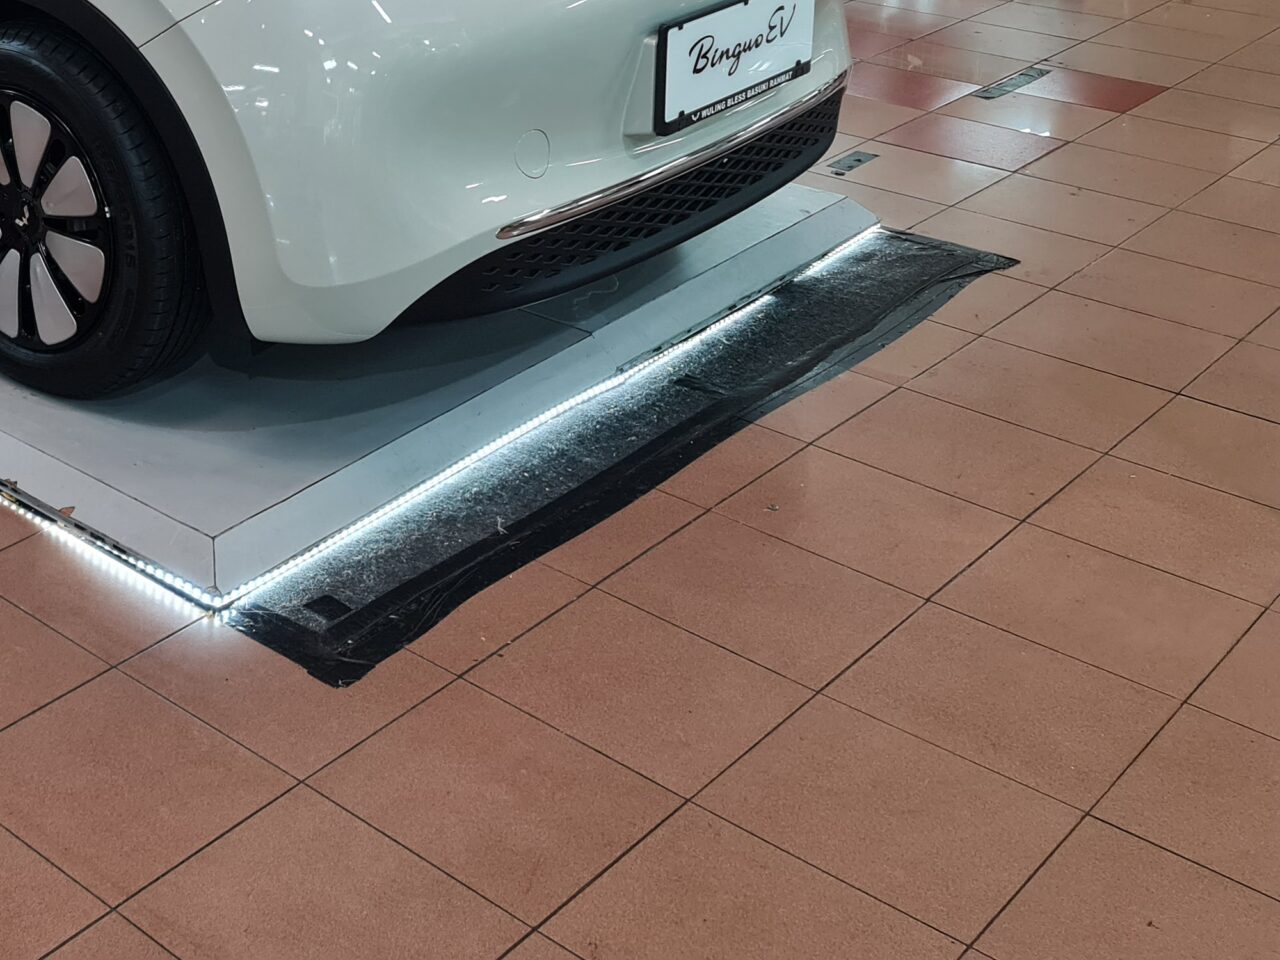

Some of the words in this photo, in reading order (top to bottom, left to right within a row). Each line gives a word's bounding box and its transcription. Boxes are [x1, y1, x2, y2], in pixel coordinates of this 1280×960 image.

[688, 34, 764, 77] Binguo
[766, 3, 797, 44] EV
[701, 100, 727, 119] WULING
[727, 92, 746, 107] BLESS
